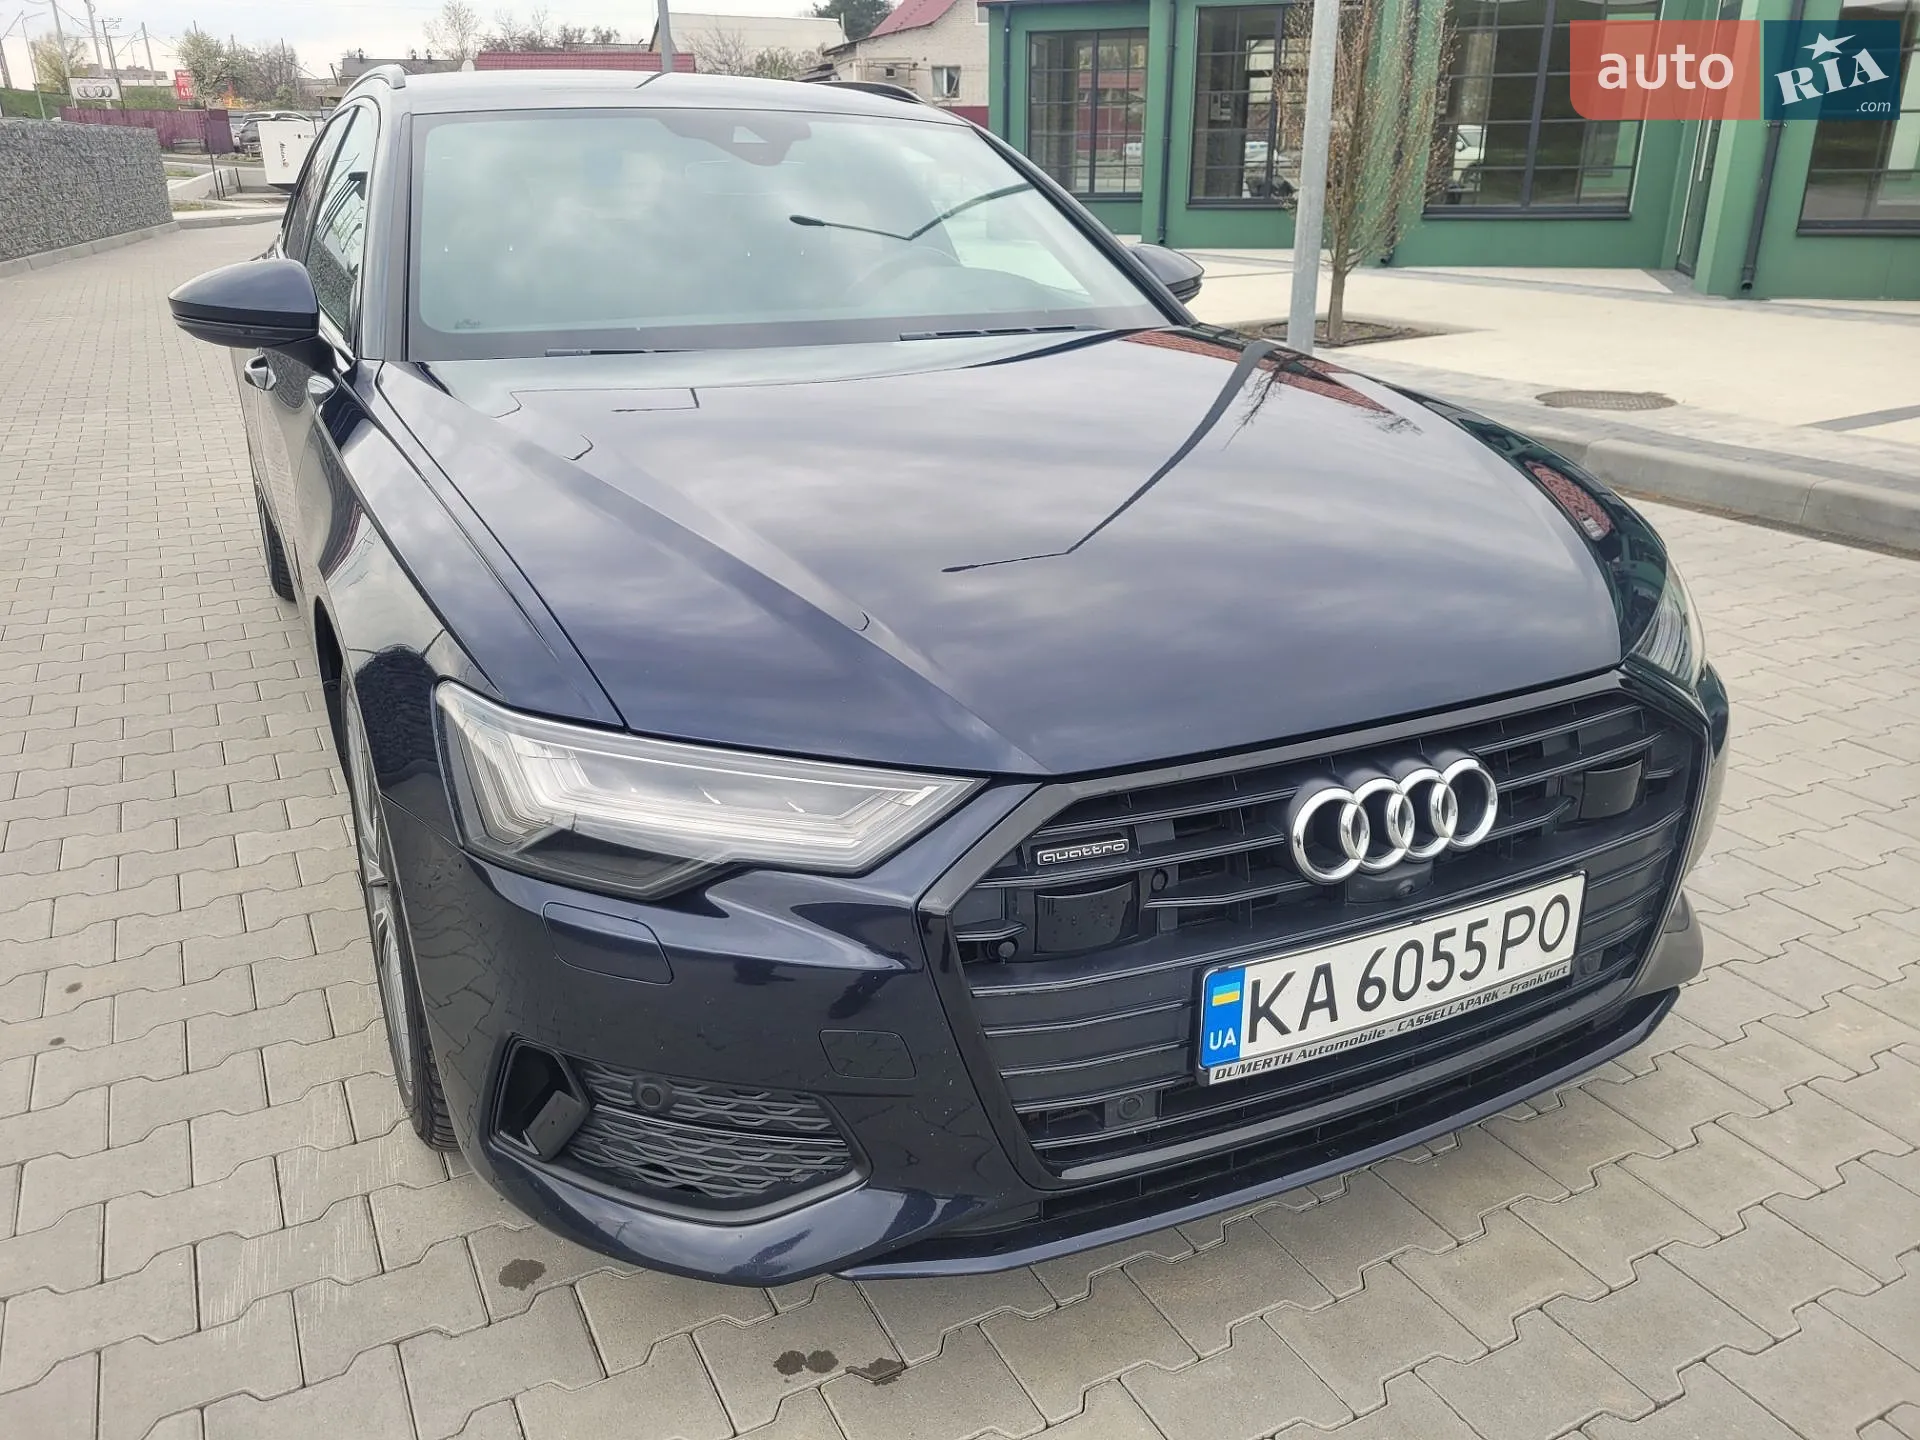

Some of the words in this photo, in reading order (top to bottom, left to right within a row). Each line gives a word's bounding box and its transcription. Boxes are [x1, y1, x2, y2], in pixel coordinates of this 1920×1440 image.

[1042, 843, 1126, 863] quattro
[1214, 1052, 1294, 1080] DUMERTH
[1295, 1027, 1386, 1060] Automobile
[1397, 989, 1500, 1032] CASSELLAPARK
[1509, 964, 1568, 994] Frankfurt
[1209, 1027, 1237, 1050] UA
